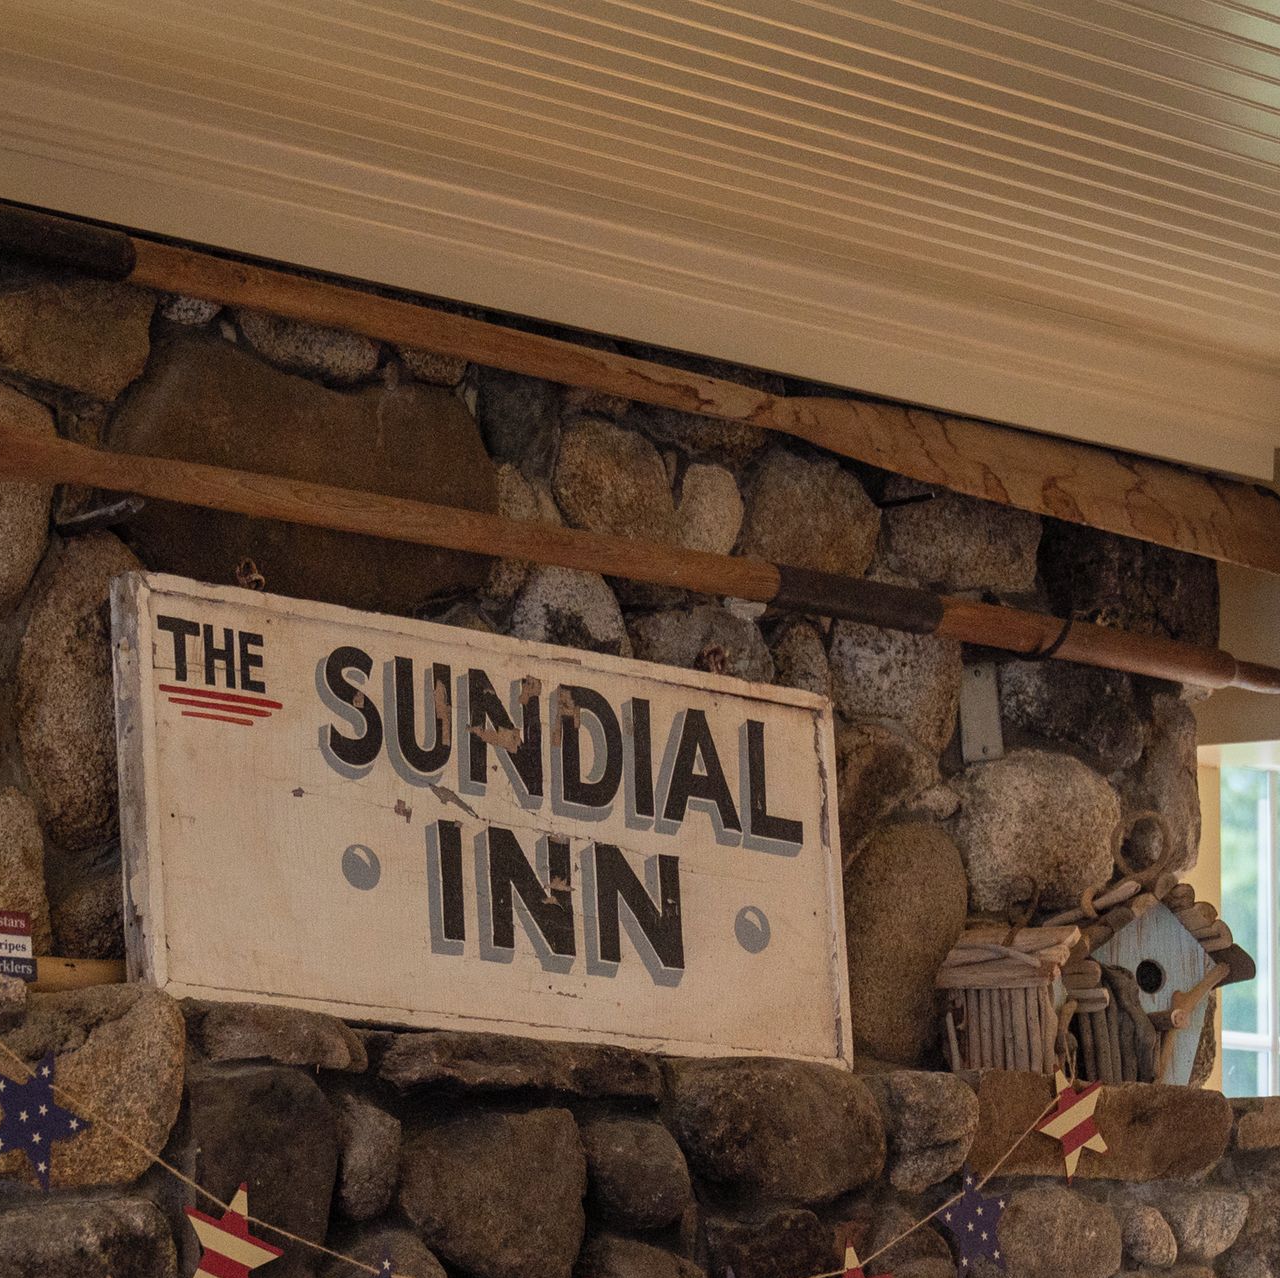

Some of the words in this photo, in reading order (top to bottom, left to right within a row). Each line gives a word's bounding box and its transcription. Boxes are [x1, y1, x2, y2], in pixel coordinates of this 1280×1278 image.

[156, 614, 266, 694] THE
[315, 646, 804, 858] SUNDIAL
[425, 819, 686, 988] INN
